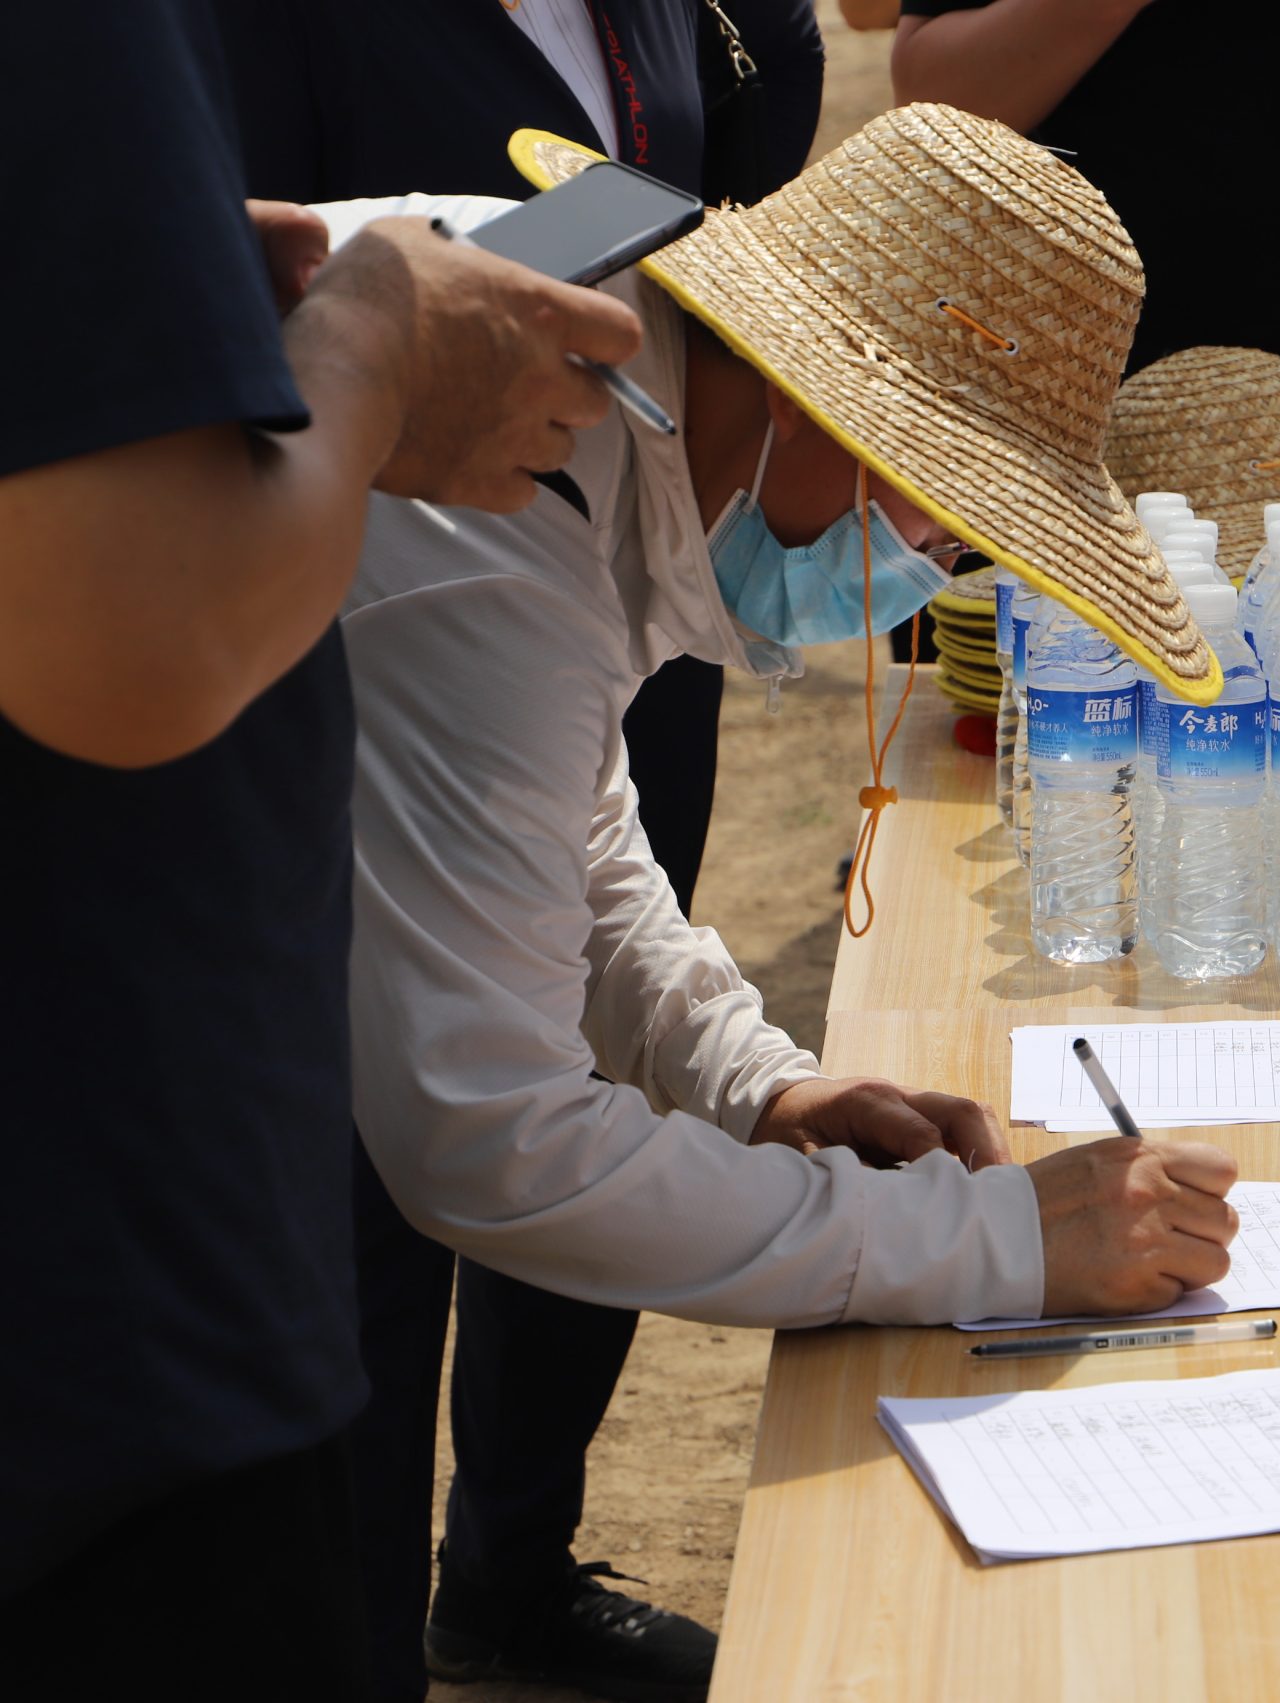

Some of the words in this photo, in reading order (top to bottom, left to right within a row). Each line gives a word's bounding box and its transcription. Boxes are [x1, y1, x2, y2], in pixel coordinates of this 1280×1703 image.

[603, 13, 648, 164] IATHLON
[1179, 709, 1239, 741] 今麦郎
[1185, 739, 1231, 753] 纯净软水
